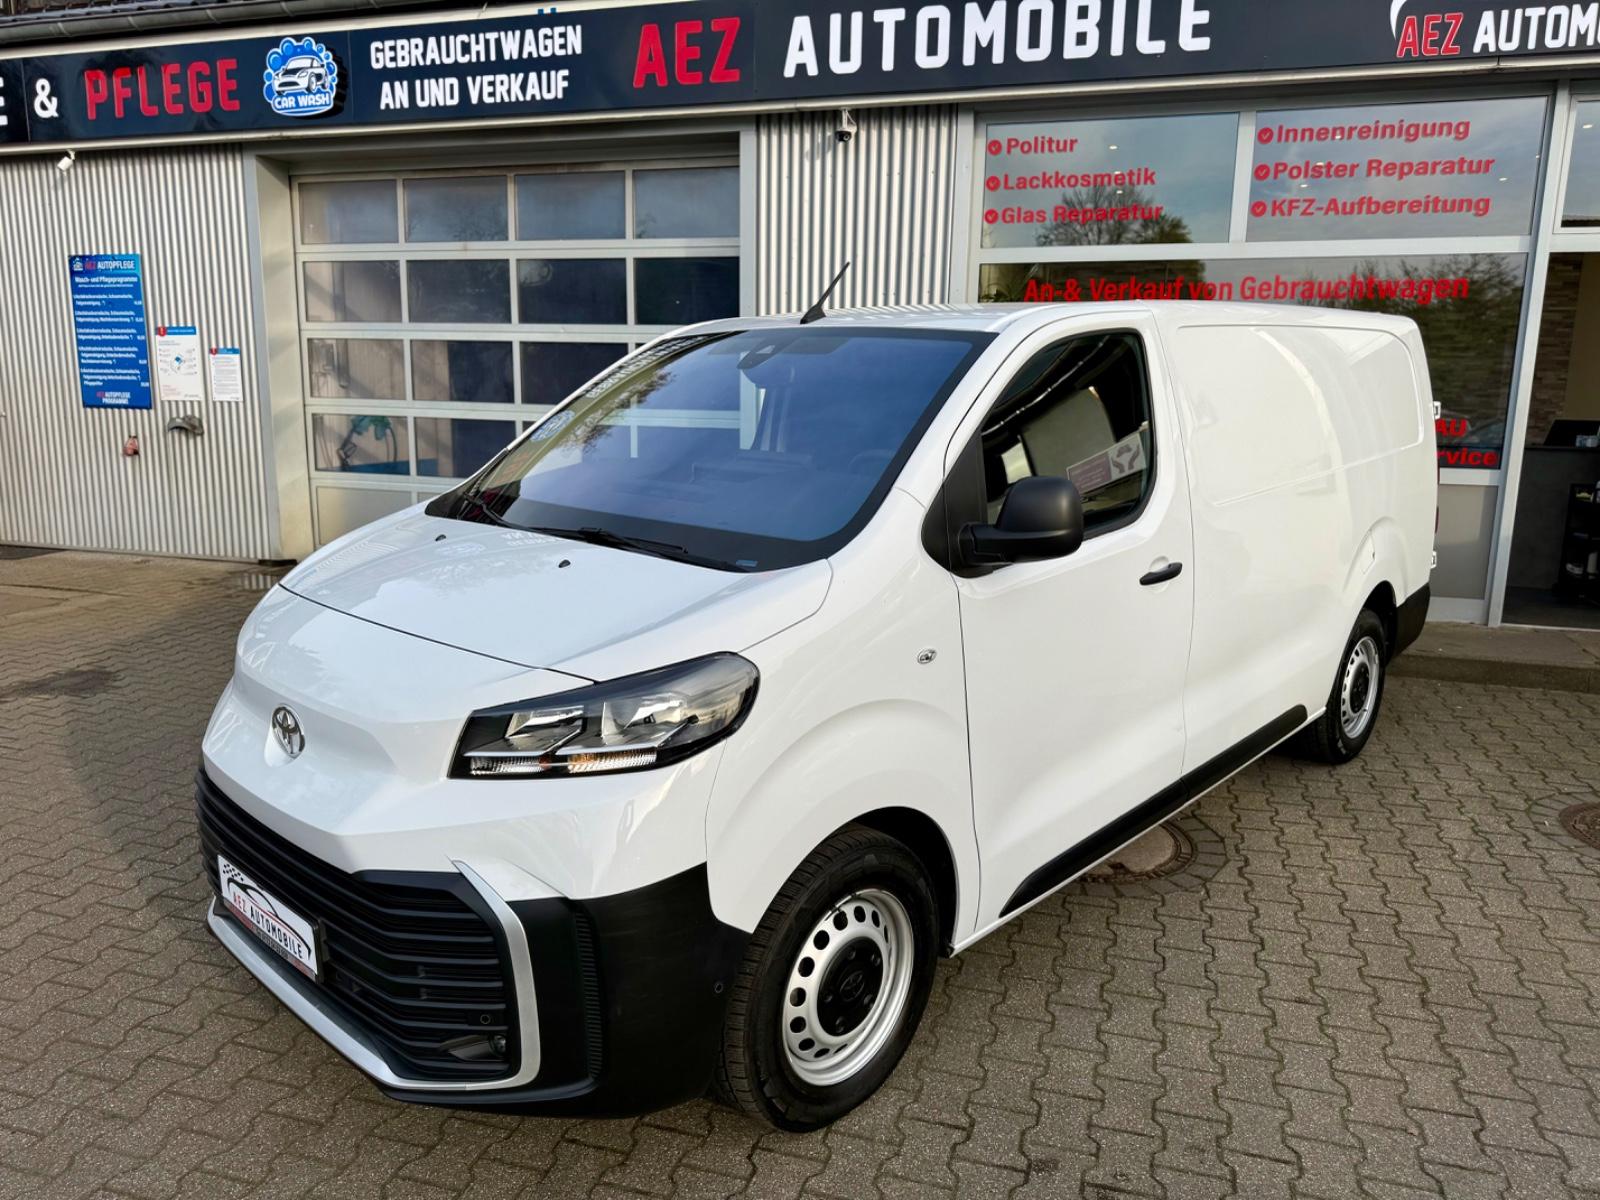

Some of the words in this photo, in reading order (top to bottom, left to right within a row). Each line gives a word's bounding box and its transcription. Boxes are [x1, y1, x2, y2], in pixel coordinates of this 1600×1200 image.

[1396, 12, 1464, 58] AEZ
[1472, 2, 1600, 54] AUTOM
[369, 25, 583, 70] GEBRAUCHTWAGEN
[632, 17, 741, 89] AEZ
[783, 0, 1211, 79] AUTOMOBILE
[33, 77, 59, 119] &
[84, 59, 240, 120] PFLEGE
[274, 96, 296, 109] CAR
[297, 93, 330, 107] WASH
[379, 81, 409, 111] AN
[415, 77, 459, 109] UND
[467, 69, 570, 105] VERKAUF
[1276, 119, 1471, 143] Innenreinigung
[1006, 136, 1078, 155] Politur
[1003, 168, 1156, 191] Lackkosmetik
[1272, 159, 1359, 180] Polster
[1366, 155, 1496, 180] Reparatur
[1001, 206, 1047, 224] Glas
[1053, 203, 1165, 226] Reparatur
[1270, 194, 1492, 218] KFZ-Aufbereitung
[1089, 275, 1186, 301] Verkauf
[1187, 281, 1234, 301] von
[1239, 272, 1469, 305] Gebrauchtwagen
[1437, 448, 1497, 466] rvice
[250, 905, 303, 959] AUTOMOBILE
